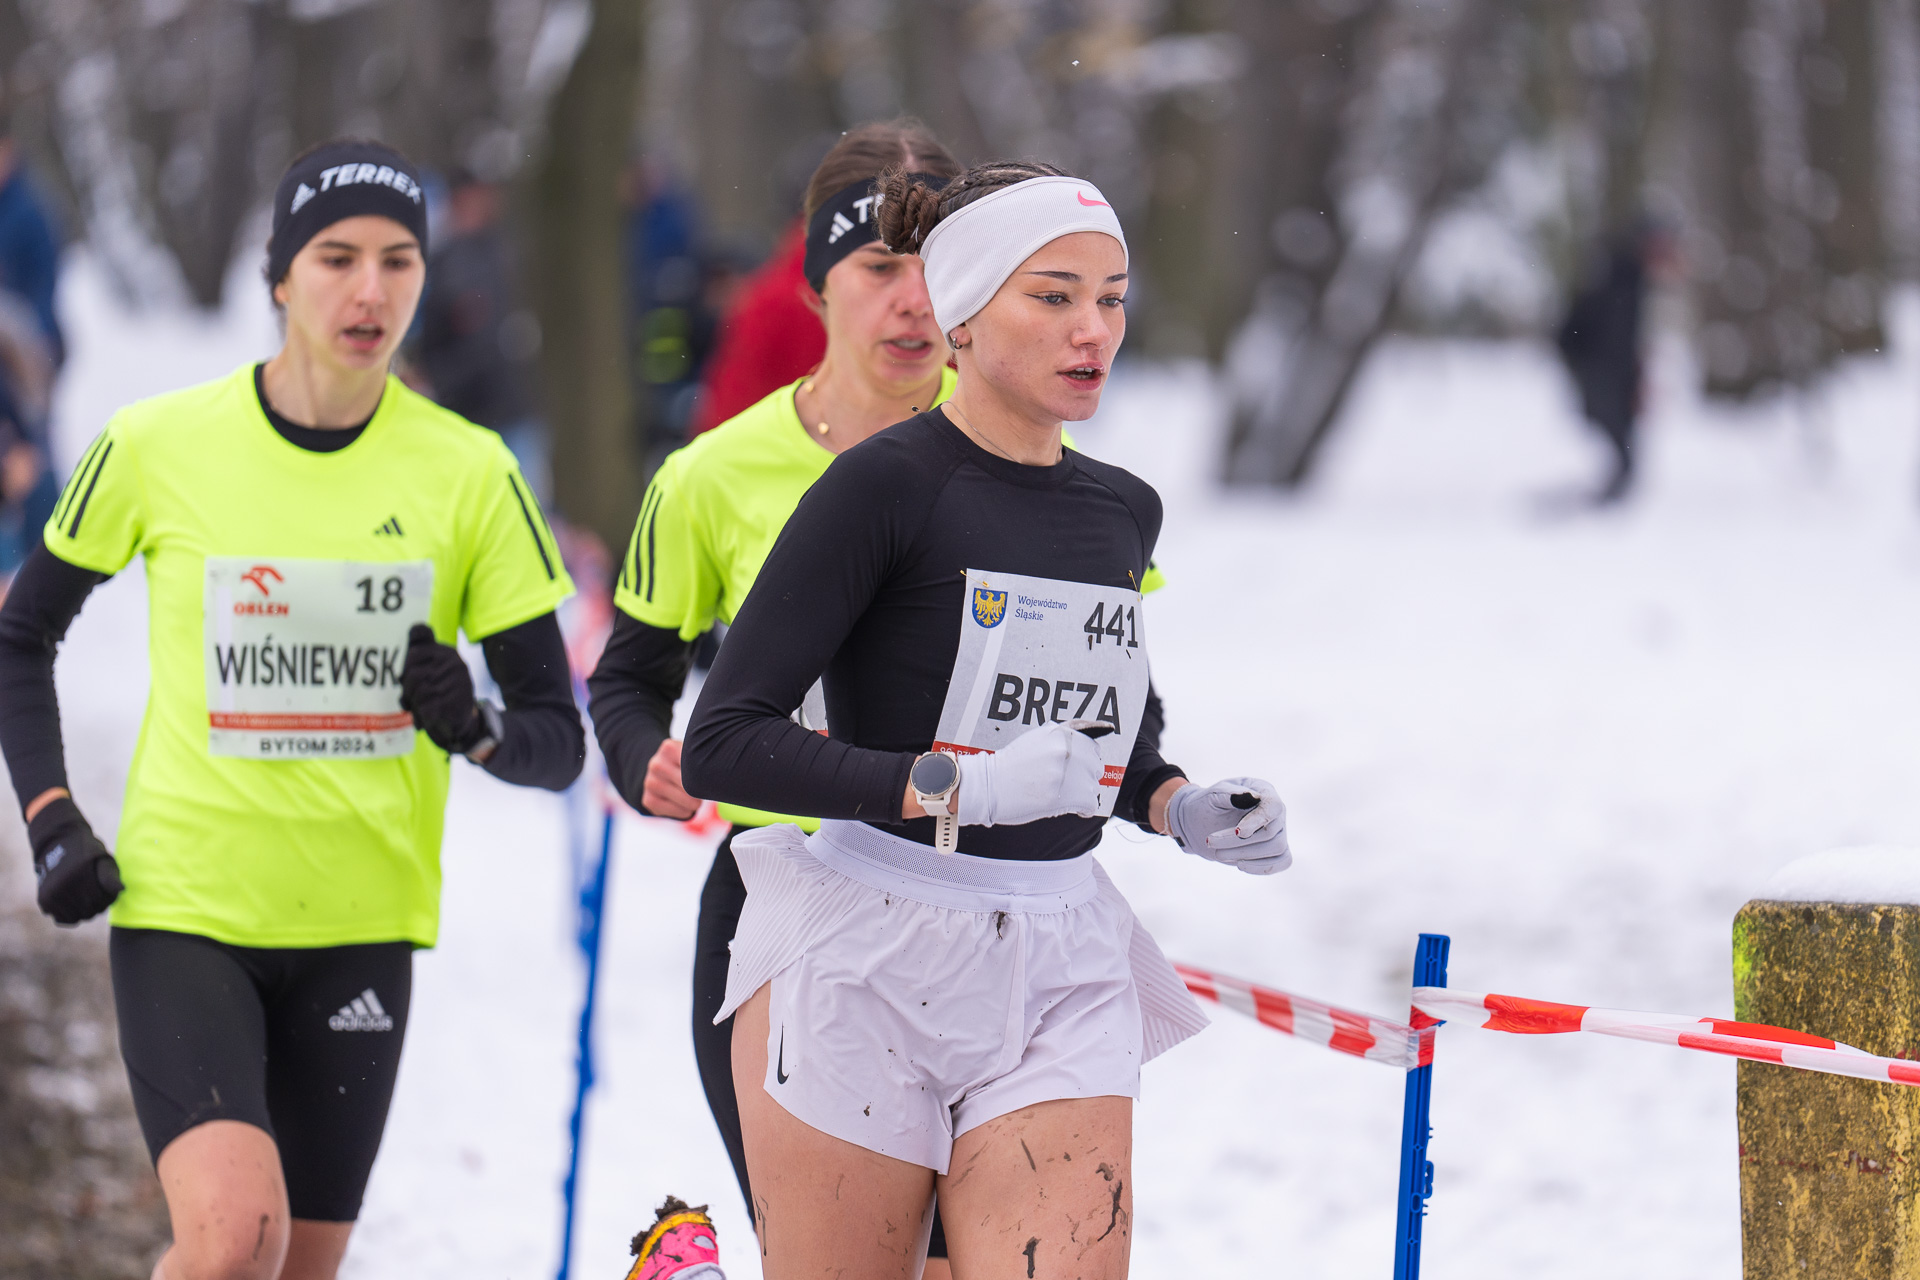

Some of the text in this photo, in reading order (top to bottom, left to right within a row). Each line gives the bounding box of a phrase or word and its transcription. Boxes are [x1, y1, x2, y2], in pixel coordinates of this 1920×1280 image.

[319, 163, 421, 205] TERREX
[234, 602, 290, 617] ORLEN
[355, 576, 405, 613] 18
[1018, 595, 1068, 610] Województwo
[1015, 607, 1044, 621] Śląskie
[1083, 602, 1139, 648] 441
[215, 633, 402, 687] WIŚNIEWSK
[987, 673, 1121, 735] BREZA
[260, 737, 376, 753] BYTOM 2024
